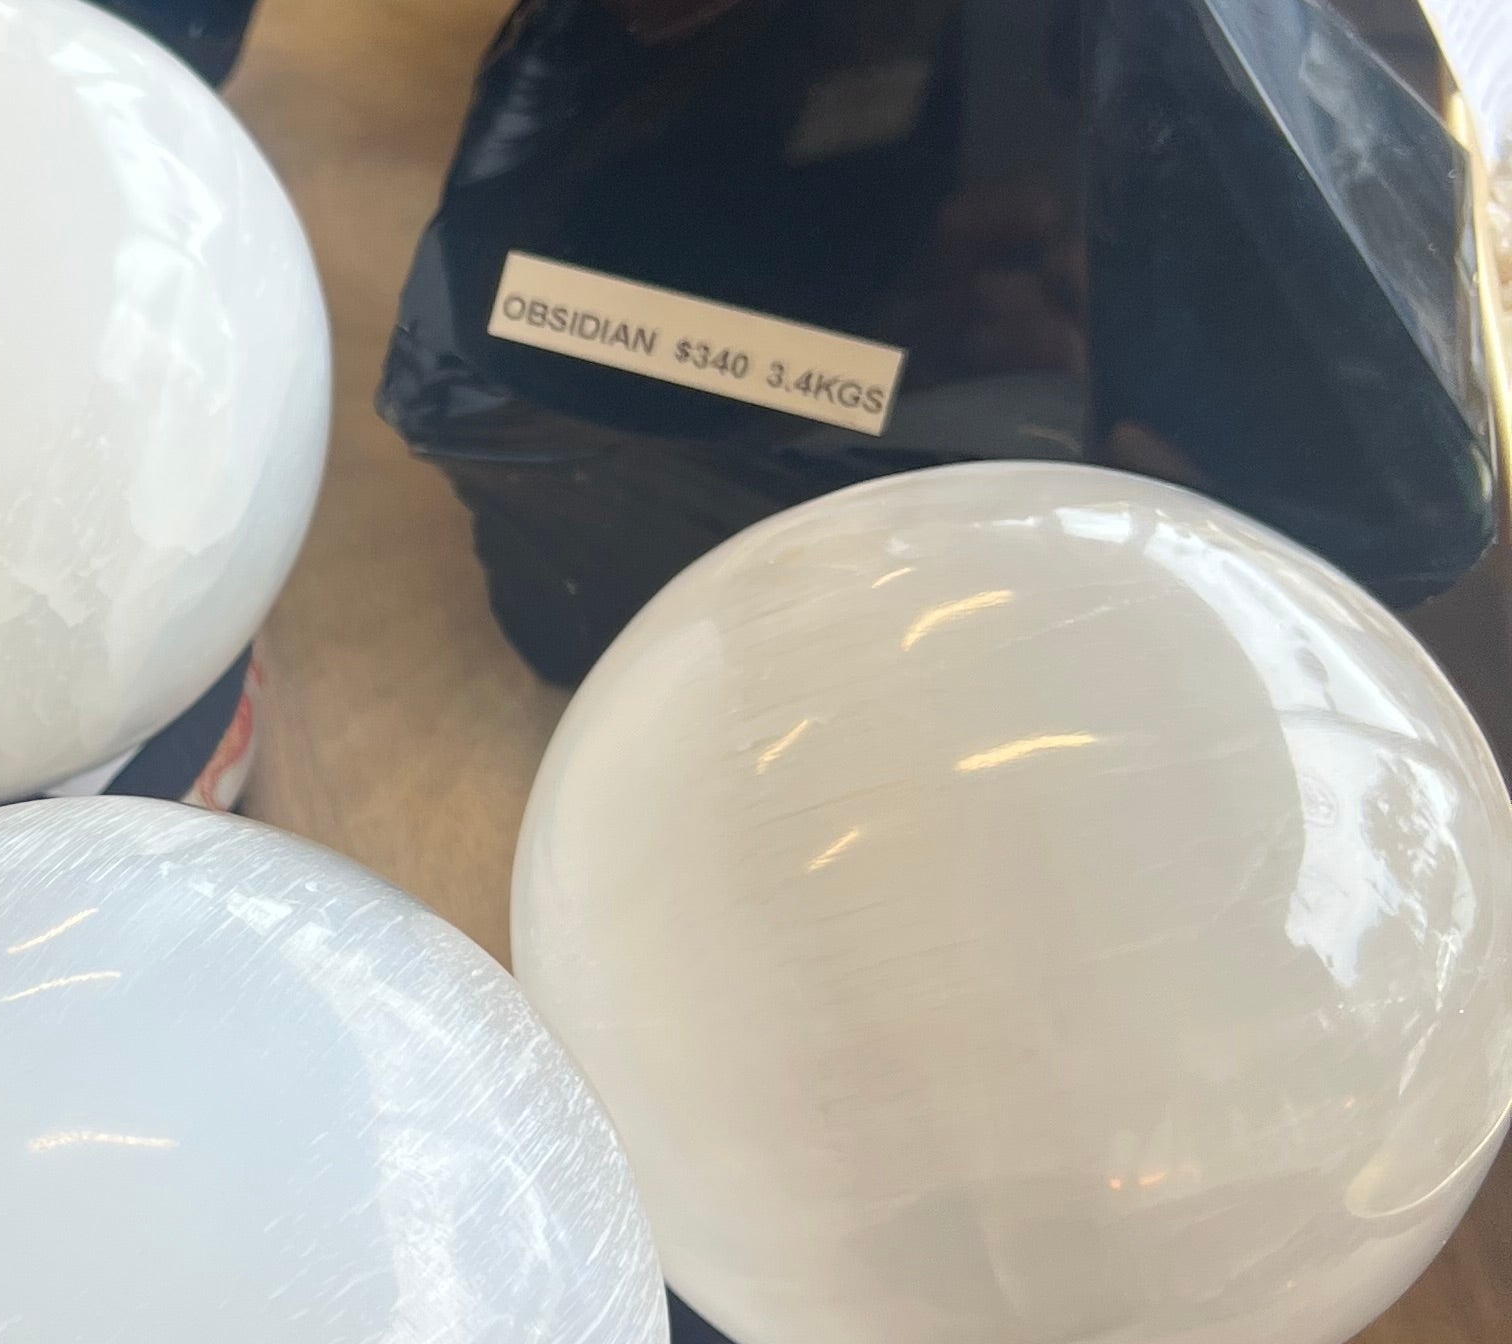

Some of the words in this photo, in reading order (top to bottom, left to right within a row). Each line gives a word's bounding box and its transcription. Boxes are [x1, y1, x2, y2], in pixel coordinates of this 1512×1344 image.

[501, 293, 660, 356] OBSIDIAN
[674, 338, 751, 381] $340
[766, 362, 886, 416] 3.4KGS
